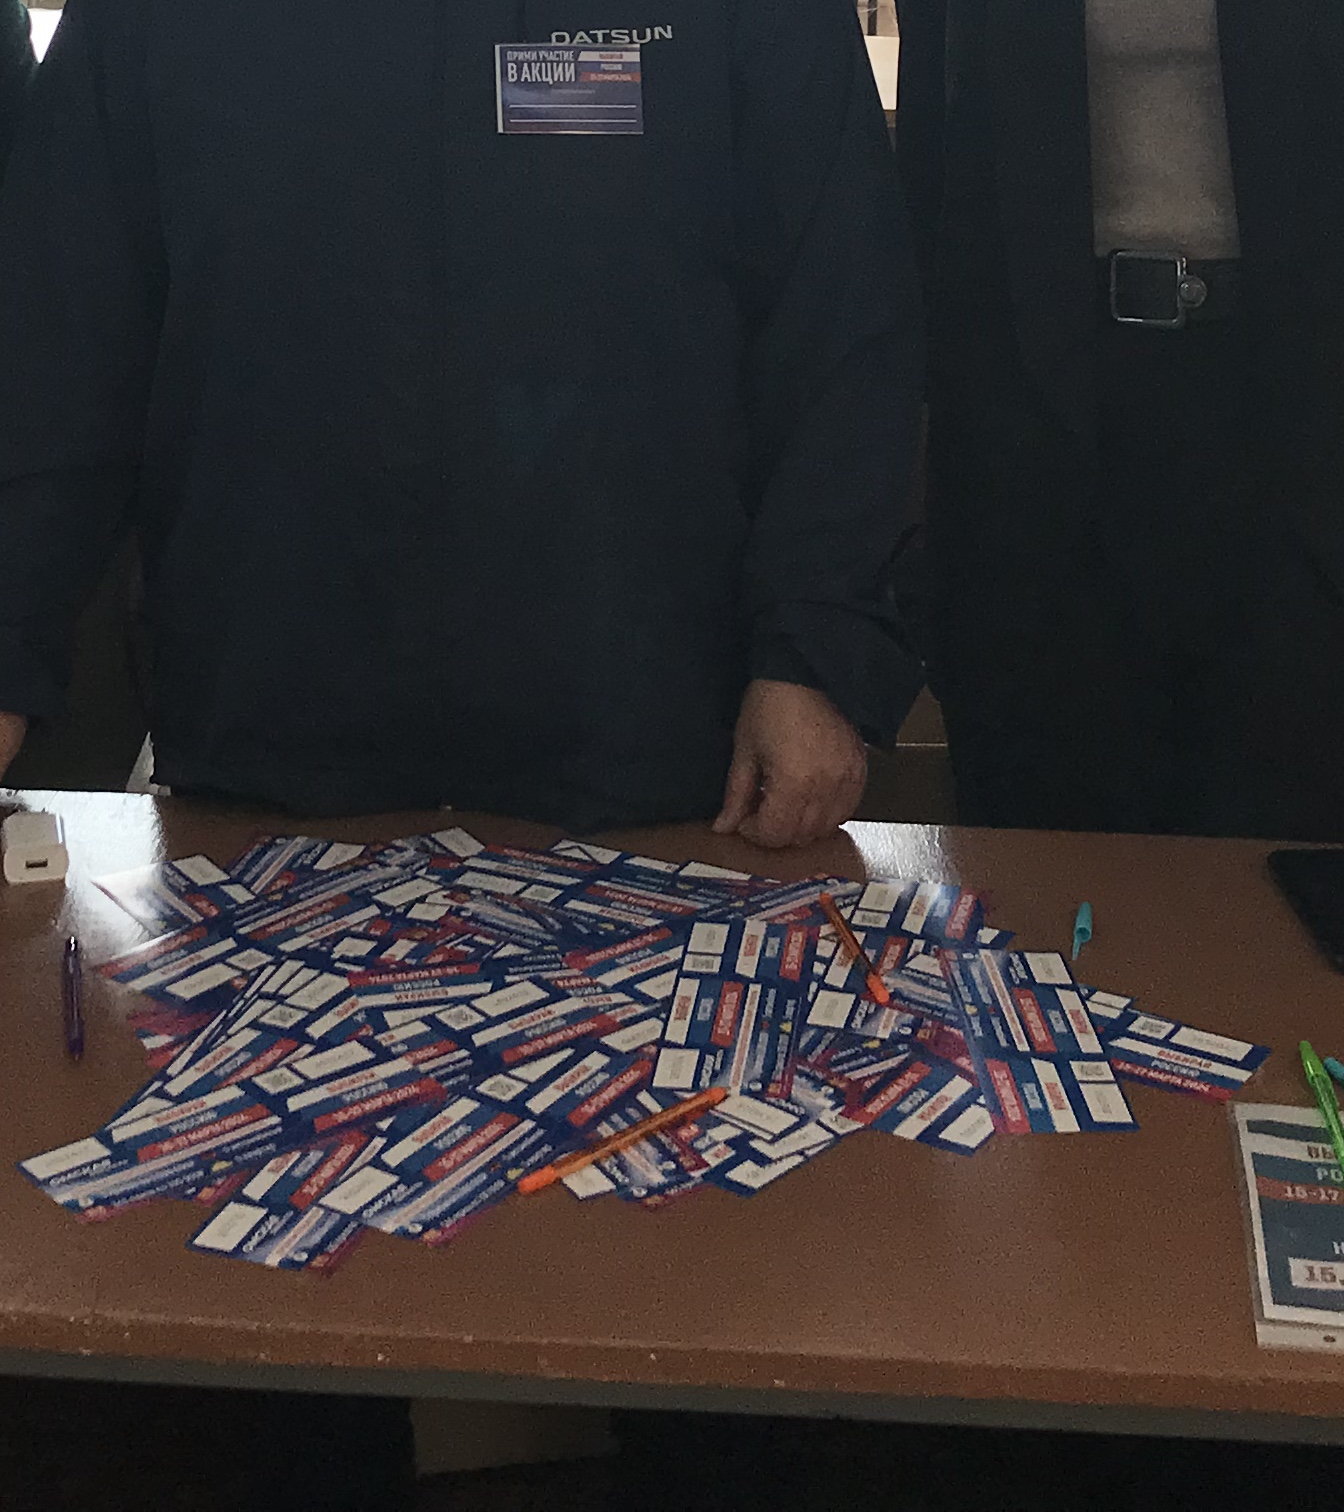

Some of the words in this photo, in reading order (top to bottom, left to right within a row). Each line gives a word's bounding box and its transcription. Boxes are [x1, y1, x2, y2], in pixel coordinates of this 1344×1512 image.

[550, 24, 673, 45] DATSUN
[507, 62, 517, 83] В
[520, 62, 576, 85] АКЦИИ
